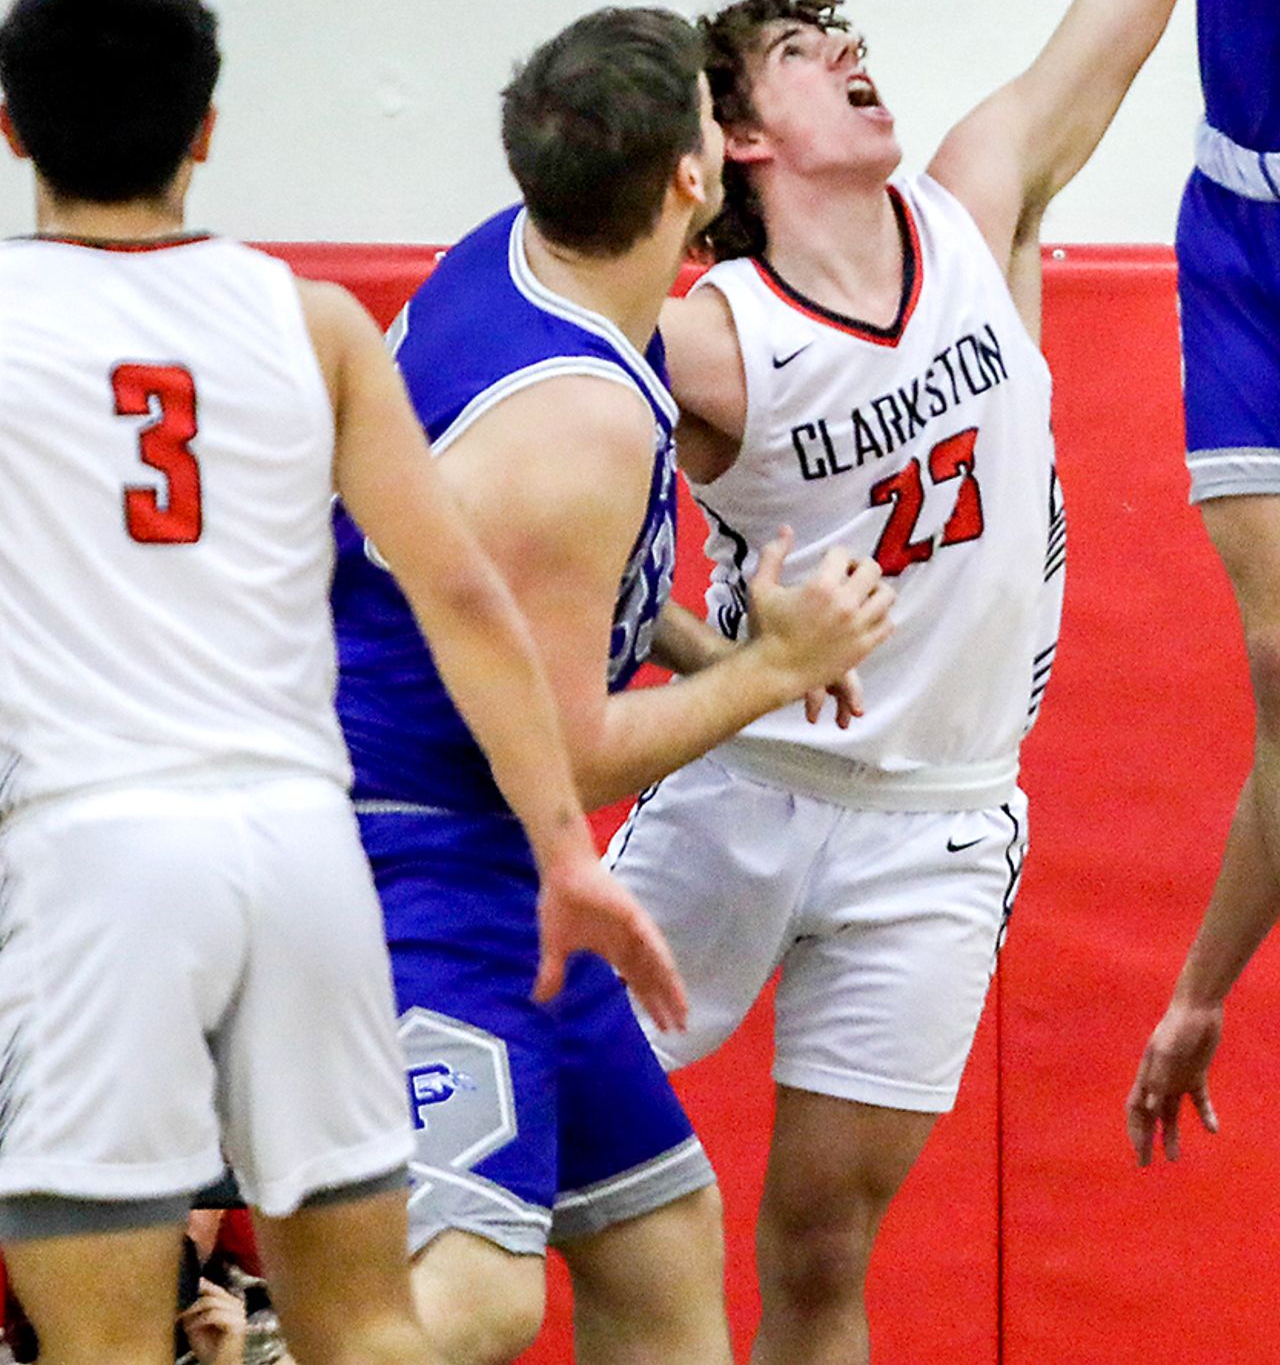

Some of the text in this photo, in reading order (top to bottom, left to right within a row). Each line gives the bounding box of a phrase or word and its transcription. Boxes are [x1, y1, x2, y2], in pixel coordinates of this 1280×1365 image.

[110, 361, 204, 545] 3
[790, 322, 1011, 482] CLARKSTON
[869, 425, 985, 578] 23
